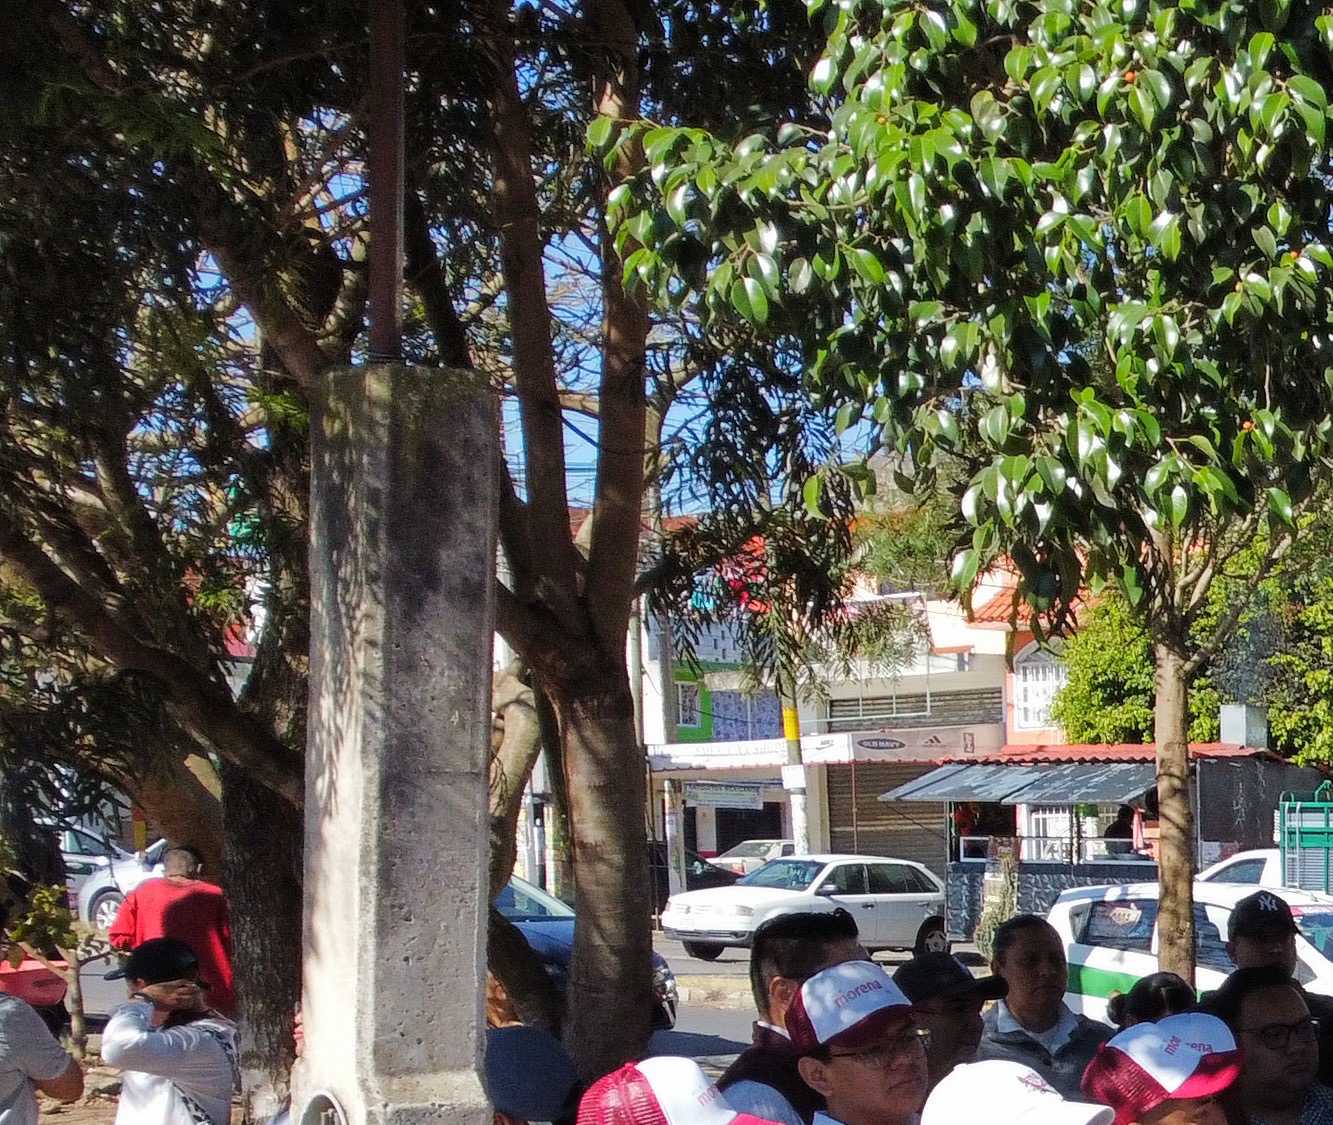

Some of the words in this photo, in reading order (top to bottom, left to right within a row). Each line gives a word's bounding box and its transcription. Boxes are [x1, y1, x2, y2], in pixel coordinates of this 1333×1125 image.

[862, 740, 879, 748] OLD
[879, 740, 901, 748] NAVY
[1258, 895, 1279, 911] NY
[834, 979, 884, 1008] morena
